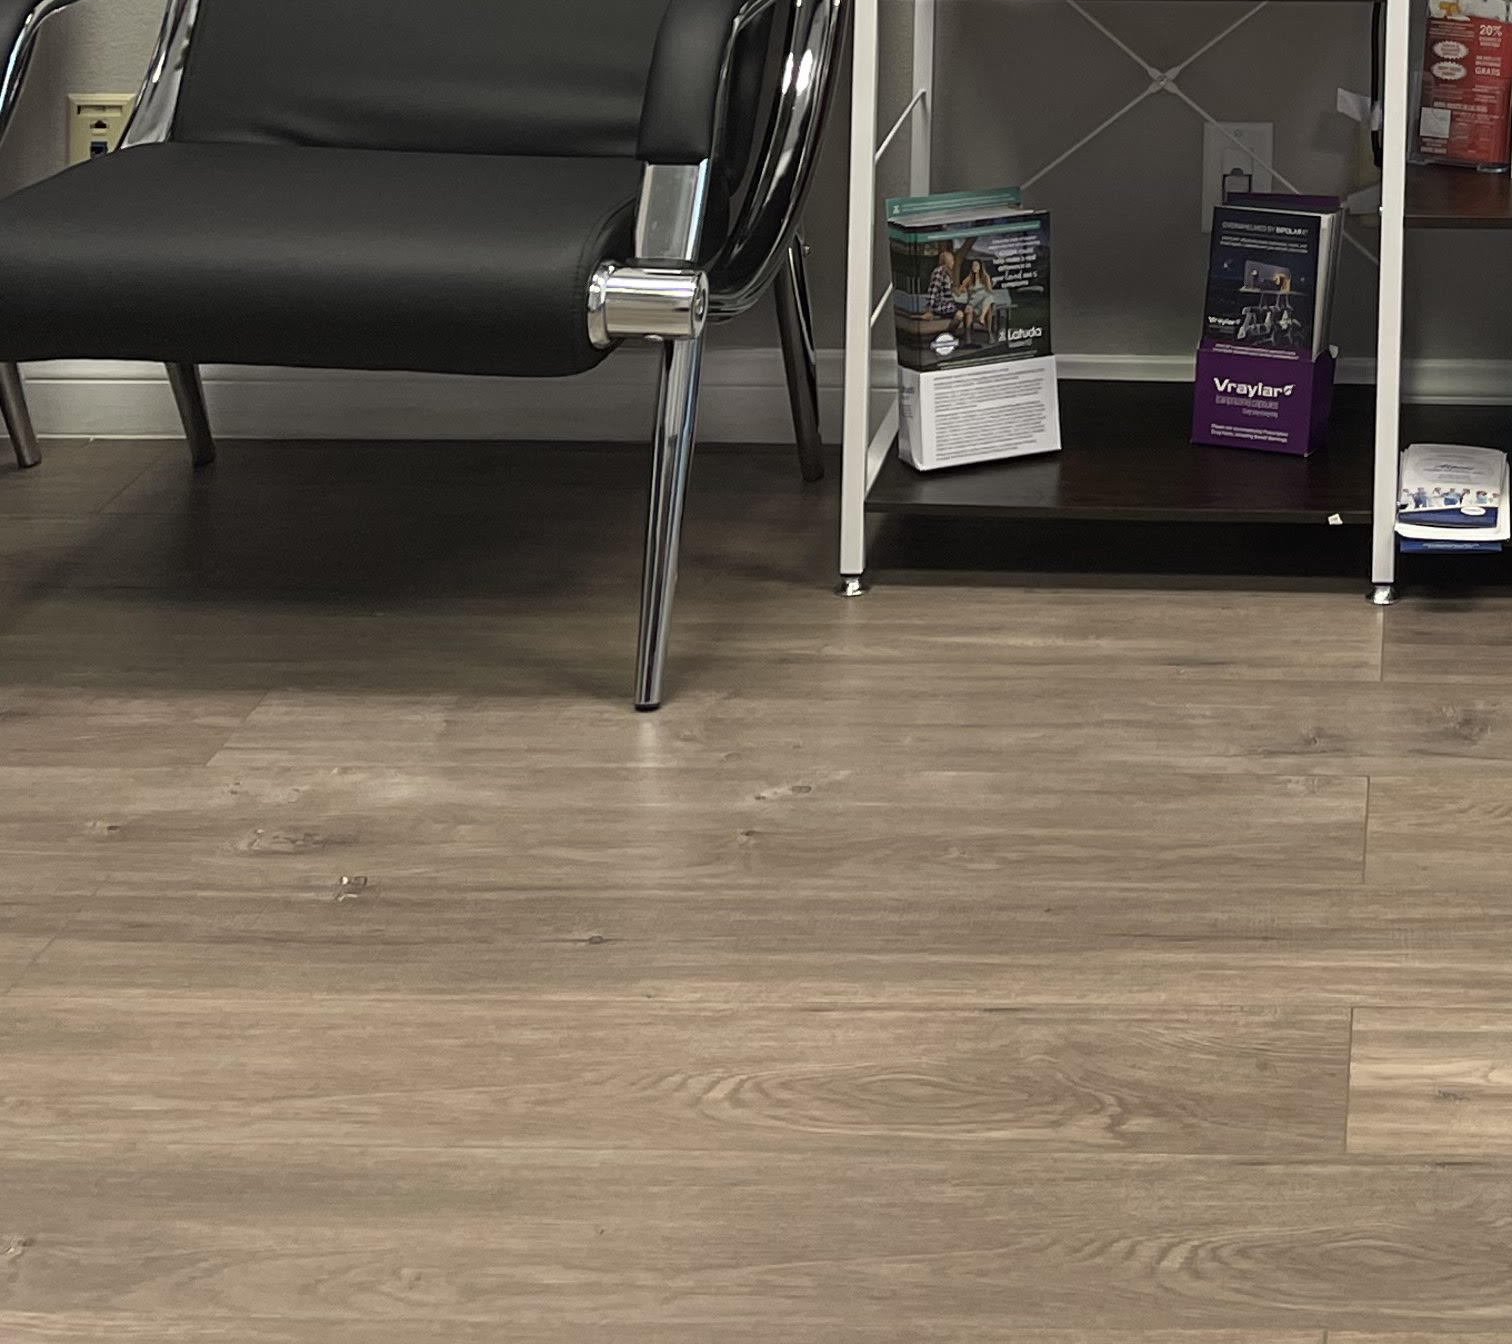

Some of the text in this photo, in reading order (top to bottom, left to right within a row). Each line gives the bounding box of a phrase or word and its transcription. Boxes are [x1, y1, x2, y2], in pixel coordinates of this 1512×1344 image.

[1479, 24, 1502, 37] 20%
[1007, 326, 1043, 341] Latuda
[1213, 377, 1283, 398] Vraylar
